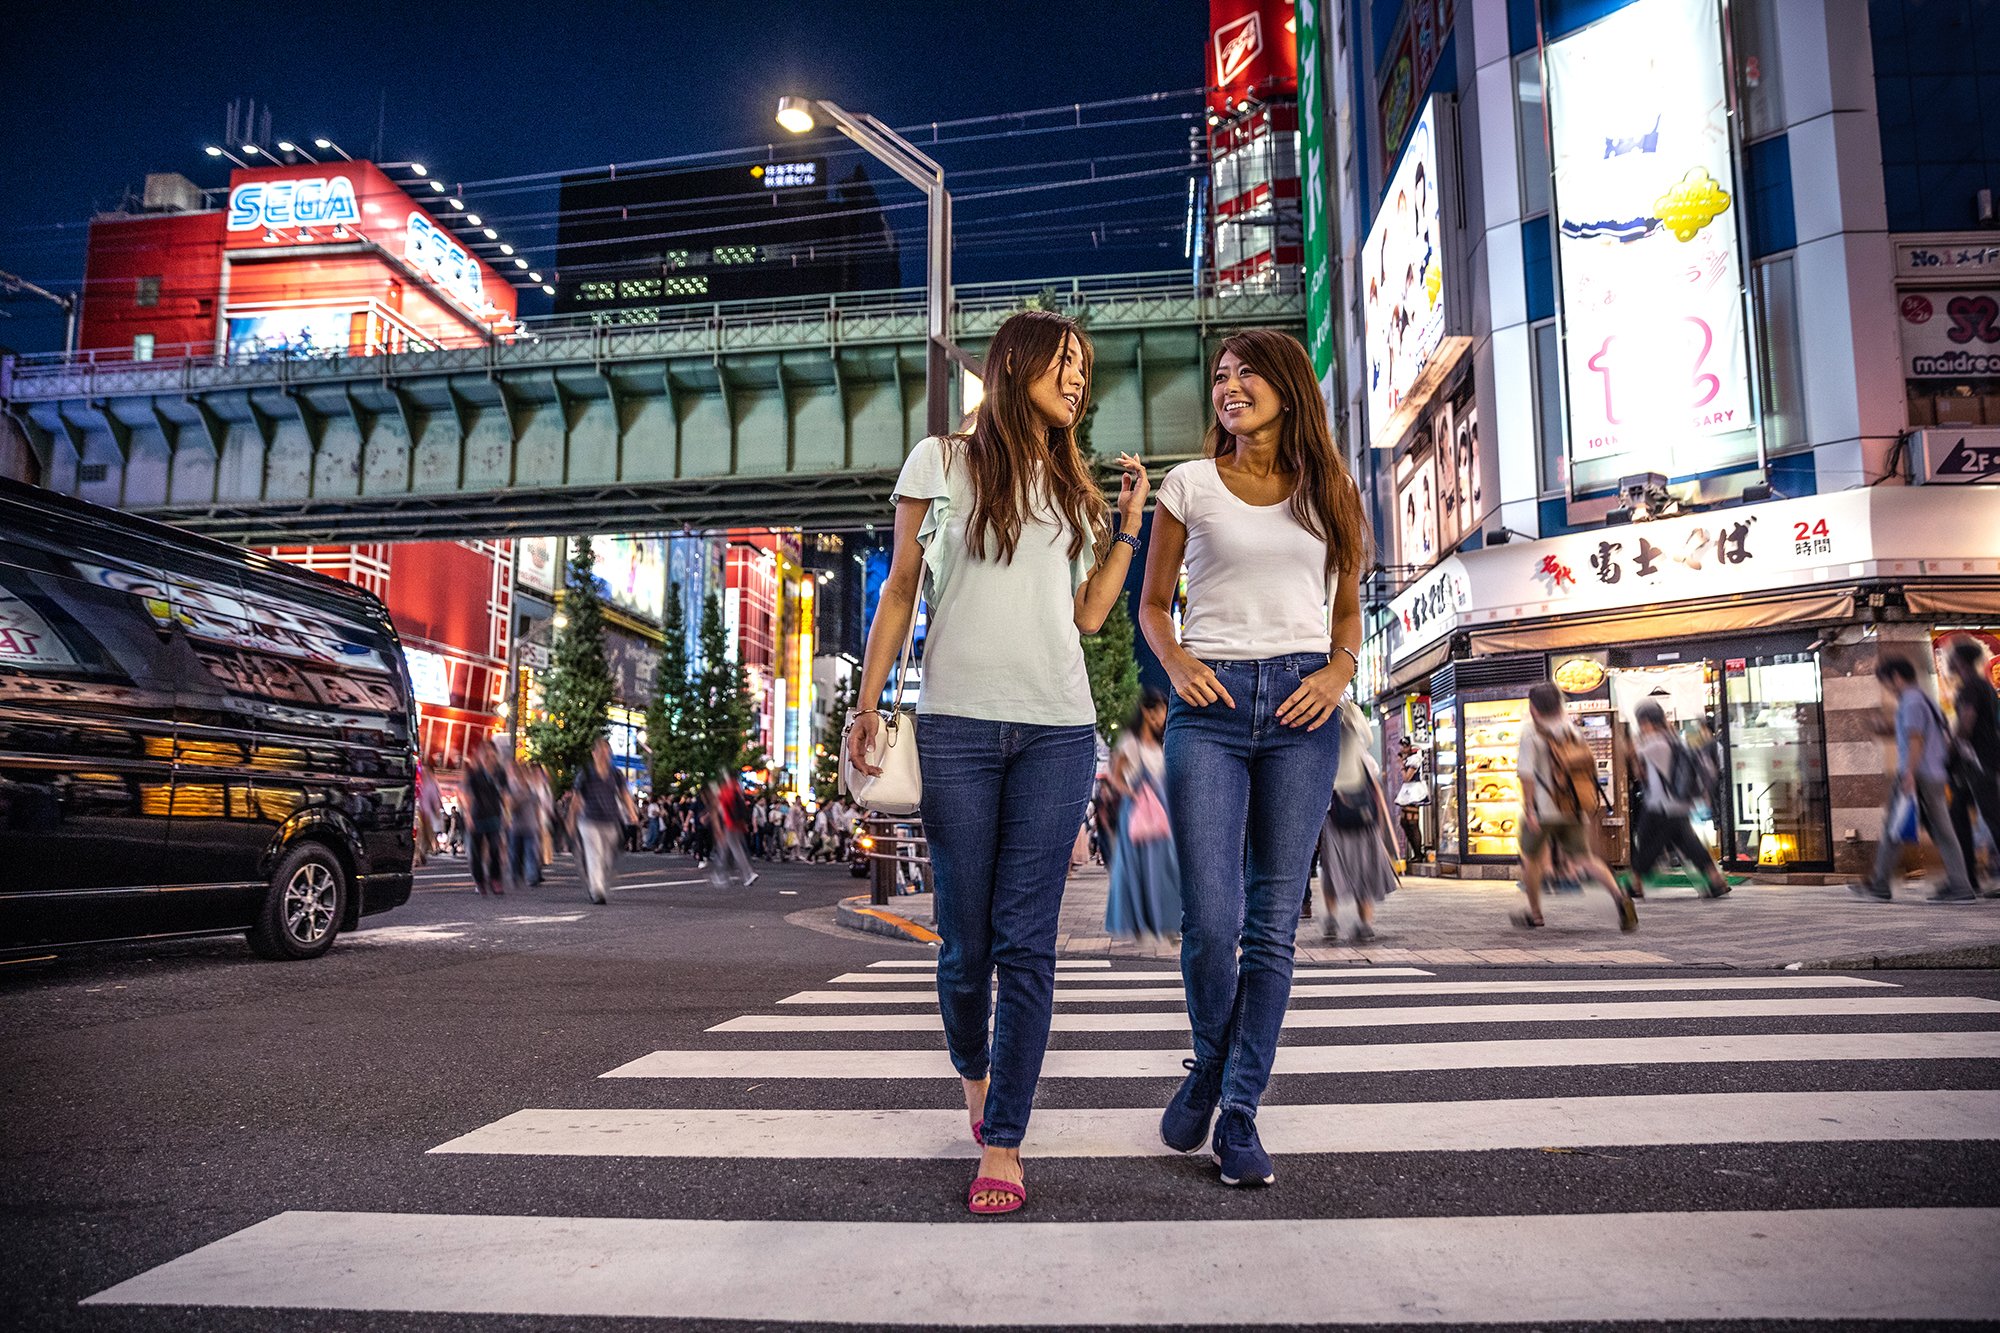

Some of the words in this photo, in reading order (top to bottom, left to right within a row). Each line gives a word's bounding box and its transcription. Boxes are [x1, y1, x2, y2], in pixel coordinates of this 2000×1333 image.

[229, 178, 358, 229] SEGA
[1961, 450, 1990, 472] 2F
[1793, 518, 1830, 541] 24
[1590, 515, 1758, 585] 富士そば
[1795, 537, 1831, 556] 時間
